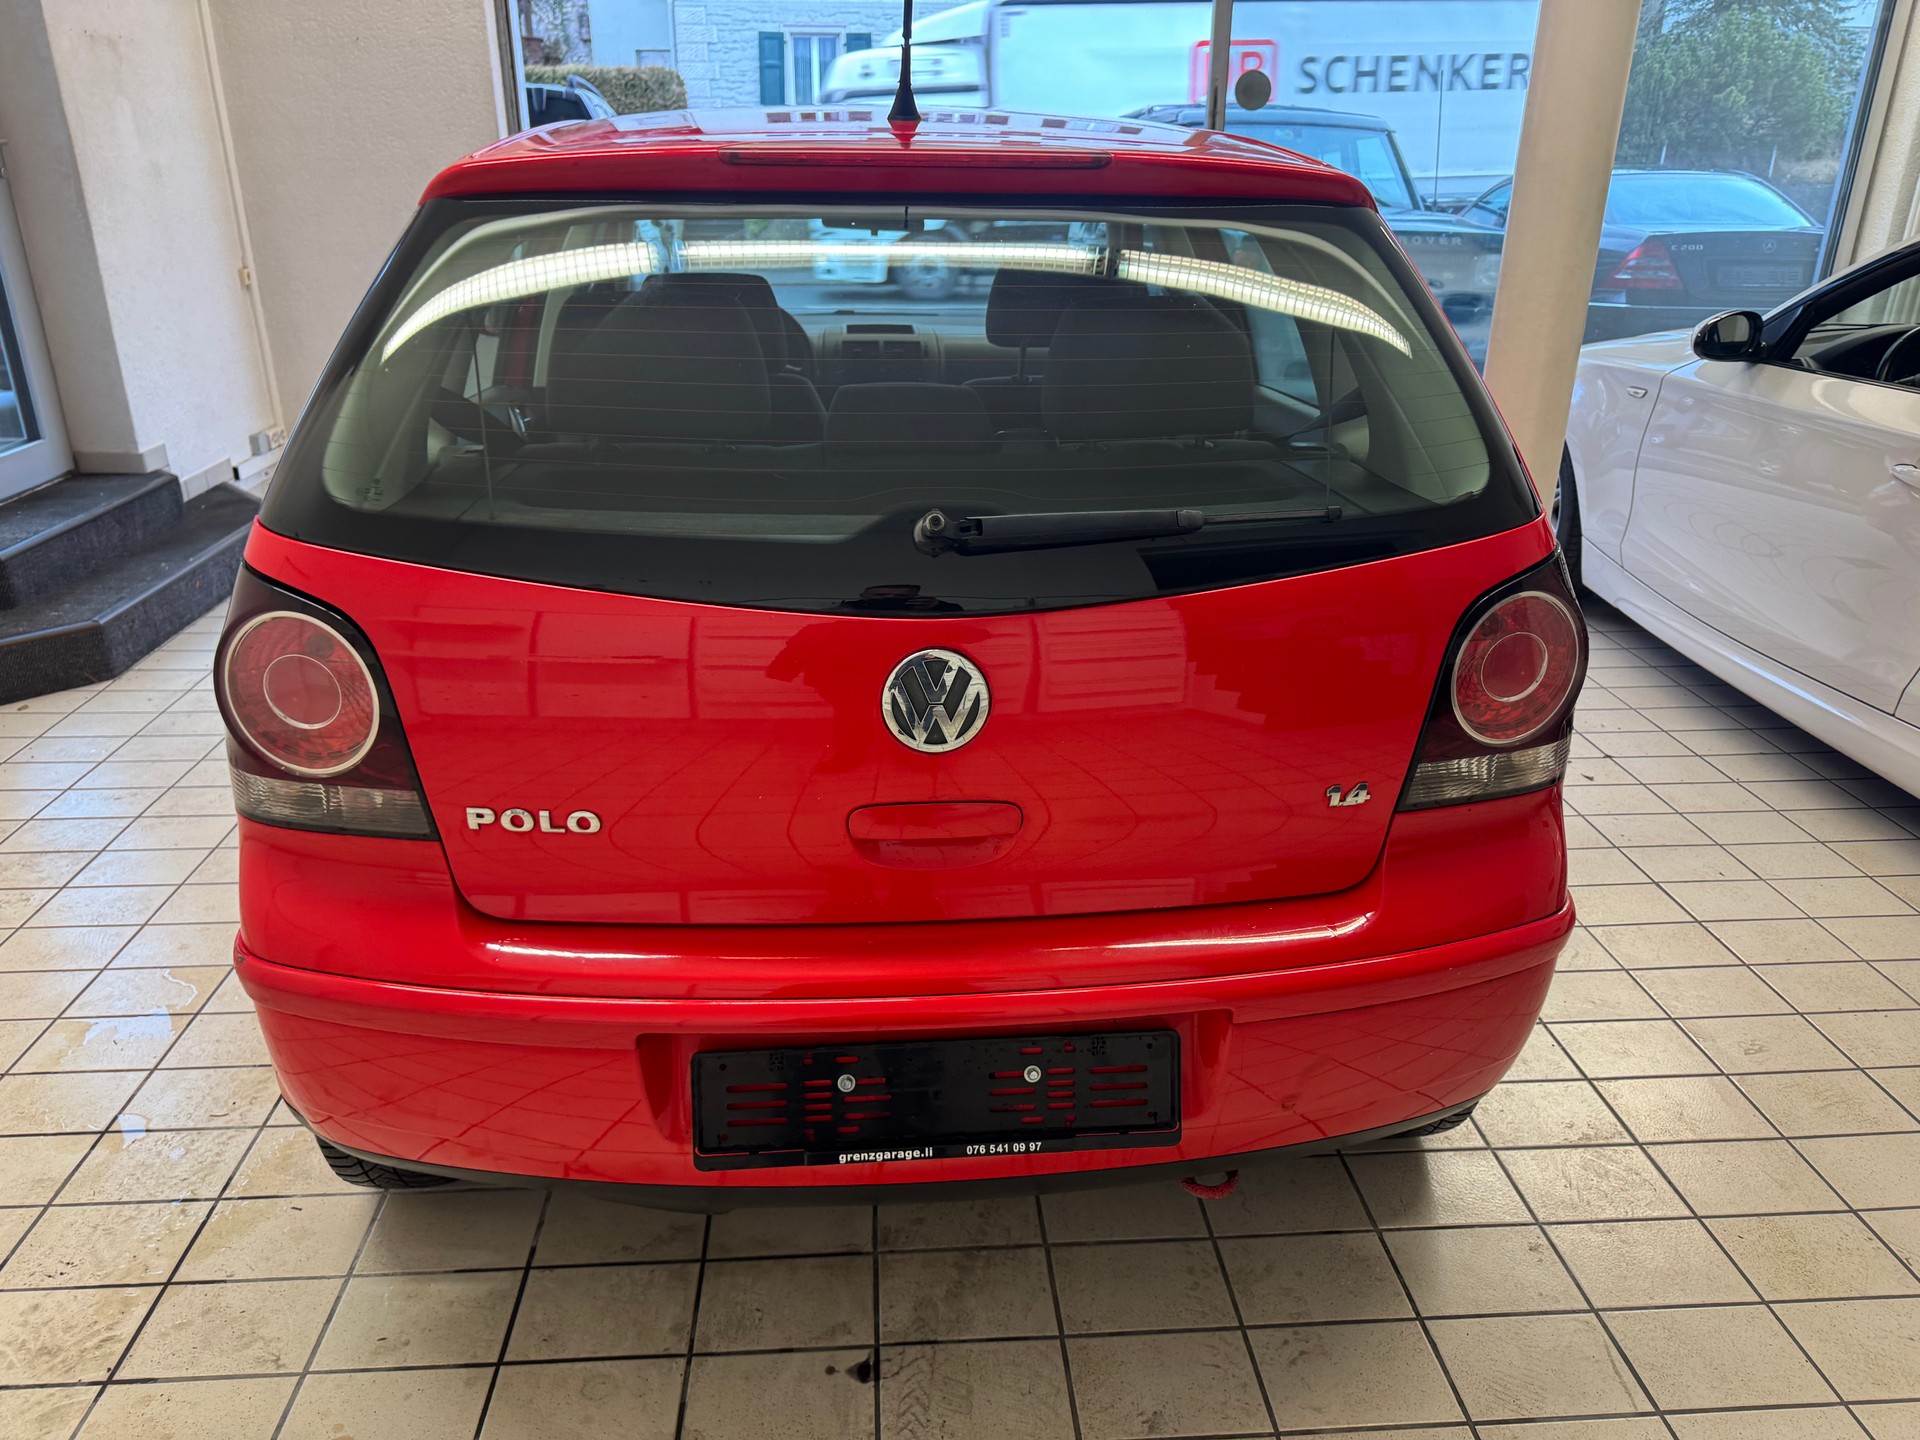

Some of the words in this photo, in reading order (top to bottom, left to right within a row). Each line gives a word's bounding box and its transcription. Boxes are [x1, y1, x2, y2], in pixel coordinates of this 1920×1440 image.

[1297, 53, 1530, 95] SCHENKER
[1326, 782, 1371, 807] 1.4
[466, 807, 601, 834] POLO
[839, 1147, 934, 1164] grenzgarage.li
[966, 1145, 986, 1155] 076
[989, 1144, 1009, 1154] 541
[1013, 1143, 1026, 1153] 09
[1029, 1142, 1042, 1152] 97
